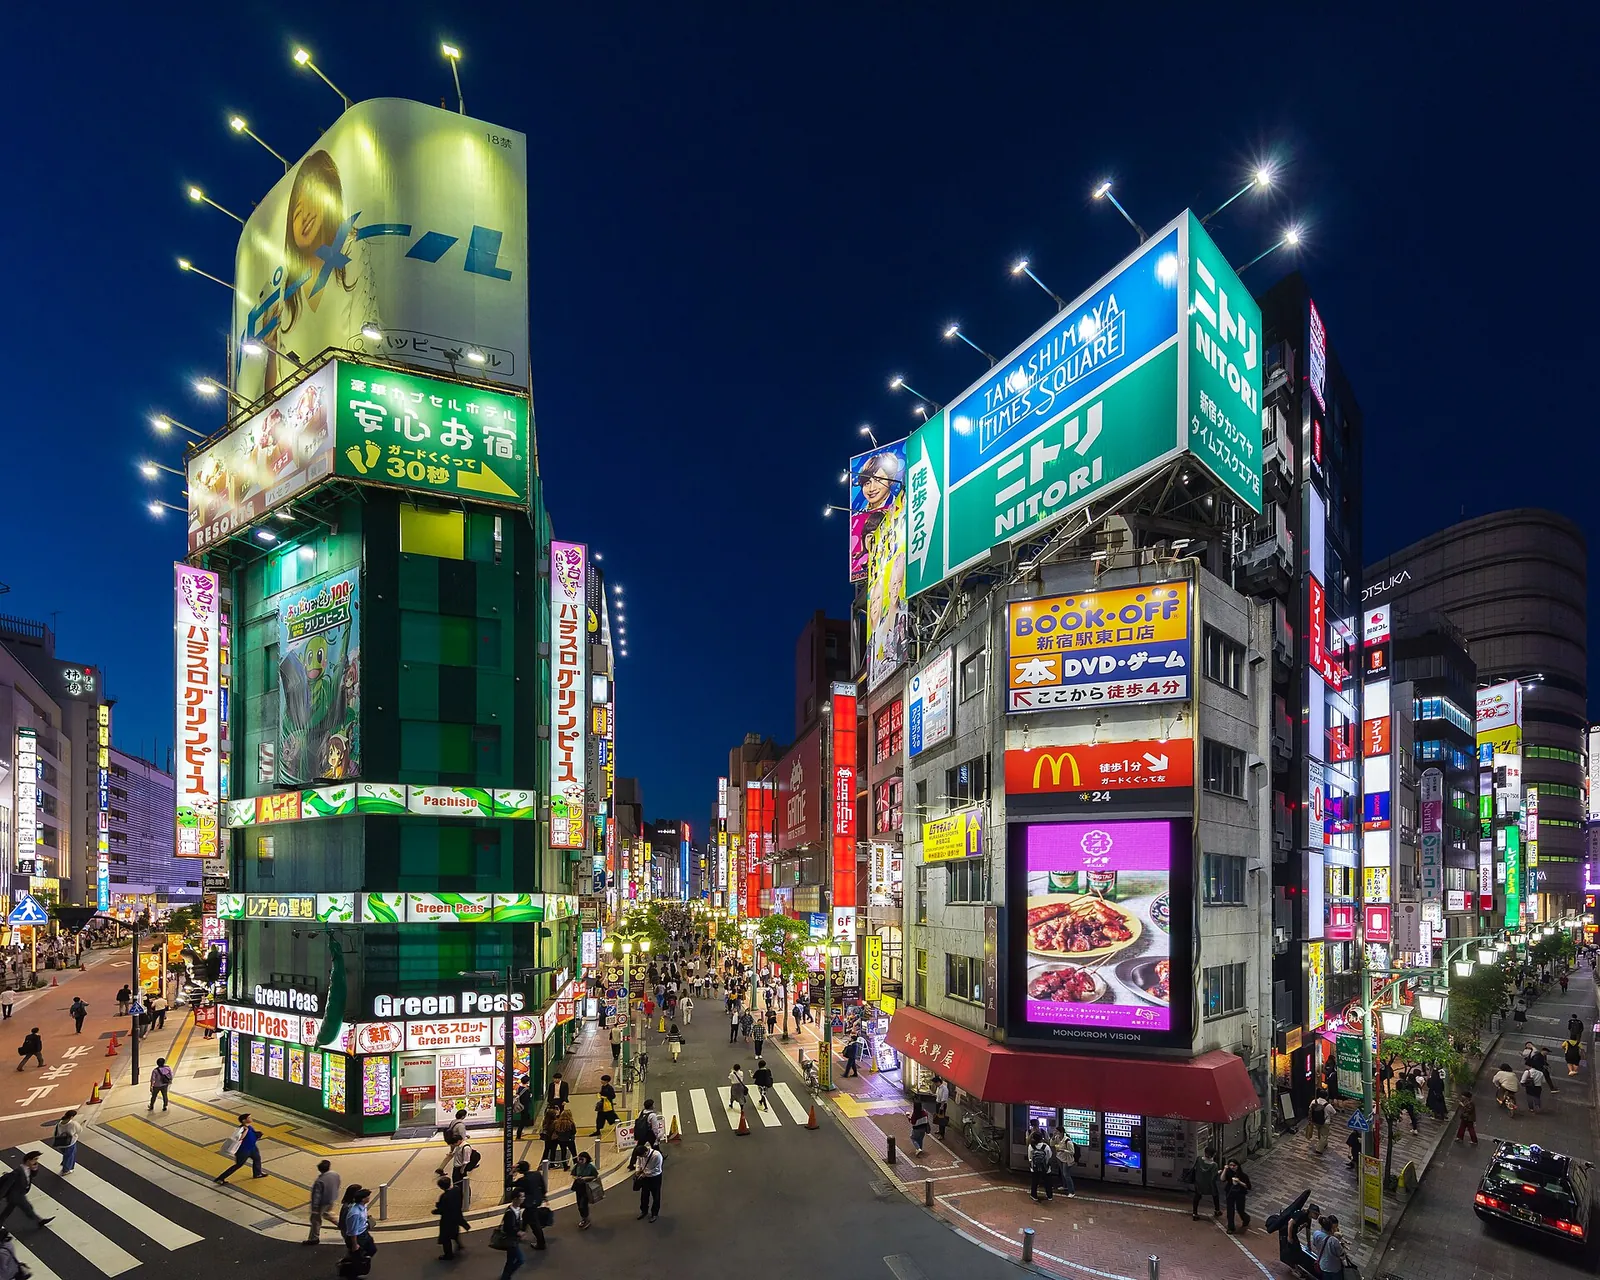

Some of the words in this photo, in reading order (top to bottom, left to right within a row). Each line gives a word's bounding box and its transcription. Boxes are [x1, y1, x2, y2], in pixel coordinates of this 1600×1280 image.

[486, 133, 512, 150] 18禁
[1195, 257, 1257, 370] ニトリ
[984, 293, 1119, 412] TAKASHIMAYA
[985, 391, 1031, 441] TIMES
[1038, 325, 1119, 416] SQUARE
[1196, 321, 1258, 416] NITORI
[351, 379, 516, 422] 豪華カプセルホテル
[350, 400, 517, 459] 安心お宿
[1200, 390, 1254, 460] 新宿タカシマヤ
[388, 444, 476, 469] ガードくぐって
[995, 400, 1103, 507] ニトリ
[1191, 416, 1260, 497] タイムズスクエア店
[386, 458, 450, 484] 30秒
[911, 467, 928, 554] 徒歩2分
[994, 456, 1102, 538] NITORI
[196, 501, 254, 547] RESORTS
[1036, 625, 1155, 650] 新宿駅東口店
[1015, 658, 1056, 684] 本
[557, 603, 580, 782] パチスログリンピース
[184, 626, 212, 796] パチスログリンピース
[1372, 719, 1382, 753] アイフル
[1100, 760, 1142, 773] 徒歩1分
[1101, 775, 1166, 785] ガードくぐって左
[424, 795, 478, 808] Pachislo
[841, 778, 852, 834] GAME
[1092, 791, 1111, 802] 24
[1424, 801, 1434, 832] Serina
[1482, 868, 1490, 892] docomo
[248, 897, 312, 918] レア台の聖地
[416, 902, 452, 914] Green
[456, 903, 484, 914] Peas
[838, 917, 851, 926] 6F
[254, 984, 288, 1008] Green
[289, 988, 318, 1012] Peas
[374, 994, 455, 1018] Green
[462, 992, 525, 1013] Peas
[218, 1005, 253, 1032] Green
[258, 1012, 288, 1038] Peas
[368, 1026, 390, 1043] 新
[410, 1021, 488, 1036] 選べるスロット
[1053, 1030, 1107, 1038] MONOKROM
[1109, 1032, 1141, 1041] VISION
[418, 1036, 450, 1046] Green
[456, 1035, 481, 1044] Peas
[919, 1038, 954, 1069] 長野屋
